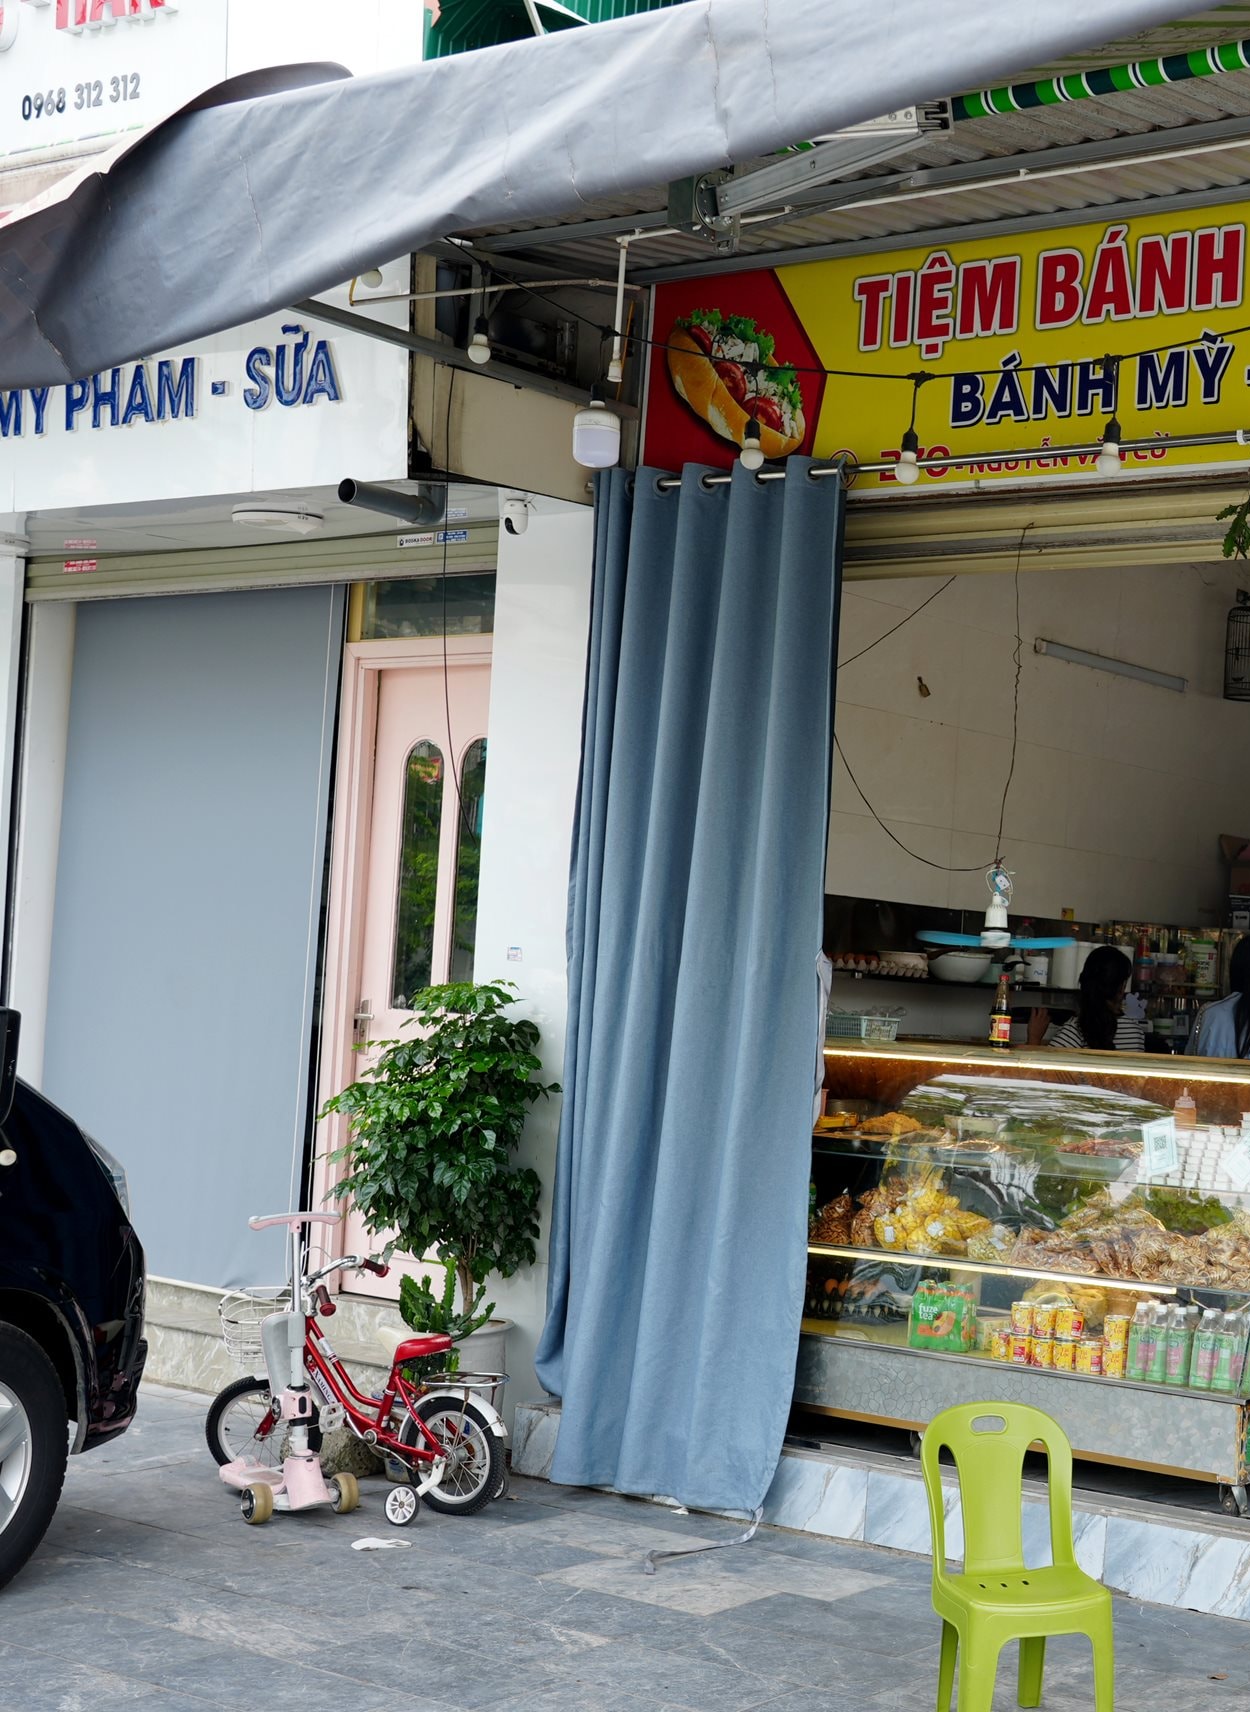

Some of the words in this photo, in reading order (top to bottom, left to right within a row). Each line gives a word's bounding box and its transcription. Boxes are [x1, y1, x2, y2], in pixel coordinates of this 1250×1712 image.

[22, 88, 66, 121] 0968
[74, 80, 103, 110] 312
[109, 72, 140, 103] 312
[853, 251, 1021, 360] TIỆM
[1036, 224, 1246, 330] BÁNH
[243, 324, 341, 410] SỮA
[949, 350, 1116, 427] BÁNH
[1134, 328, 1235, 410] MỲ
[918, 1303, 939, 1314] fuze
[919, 1311, 934, 1321] tea
